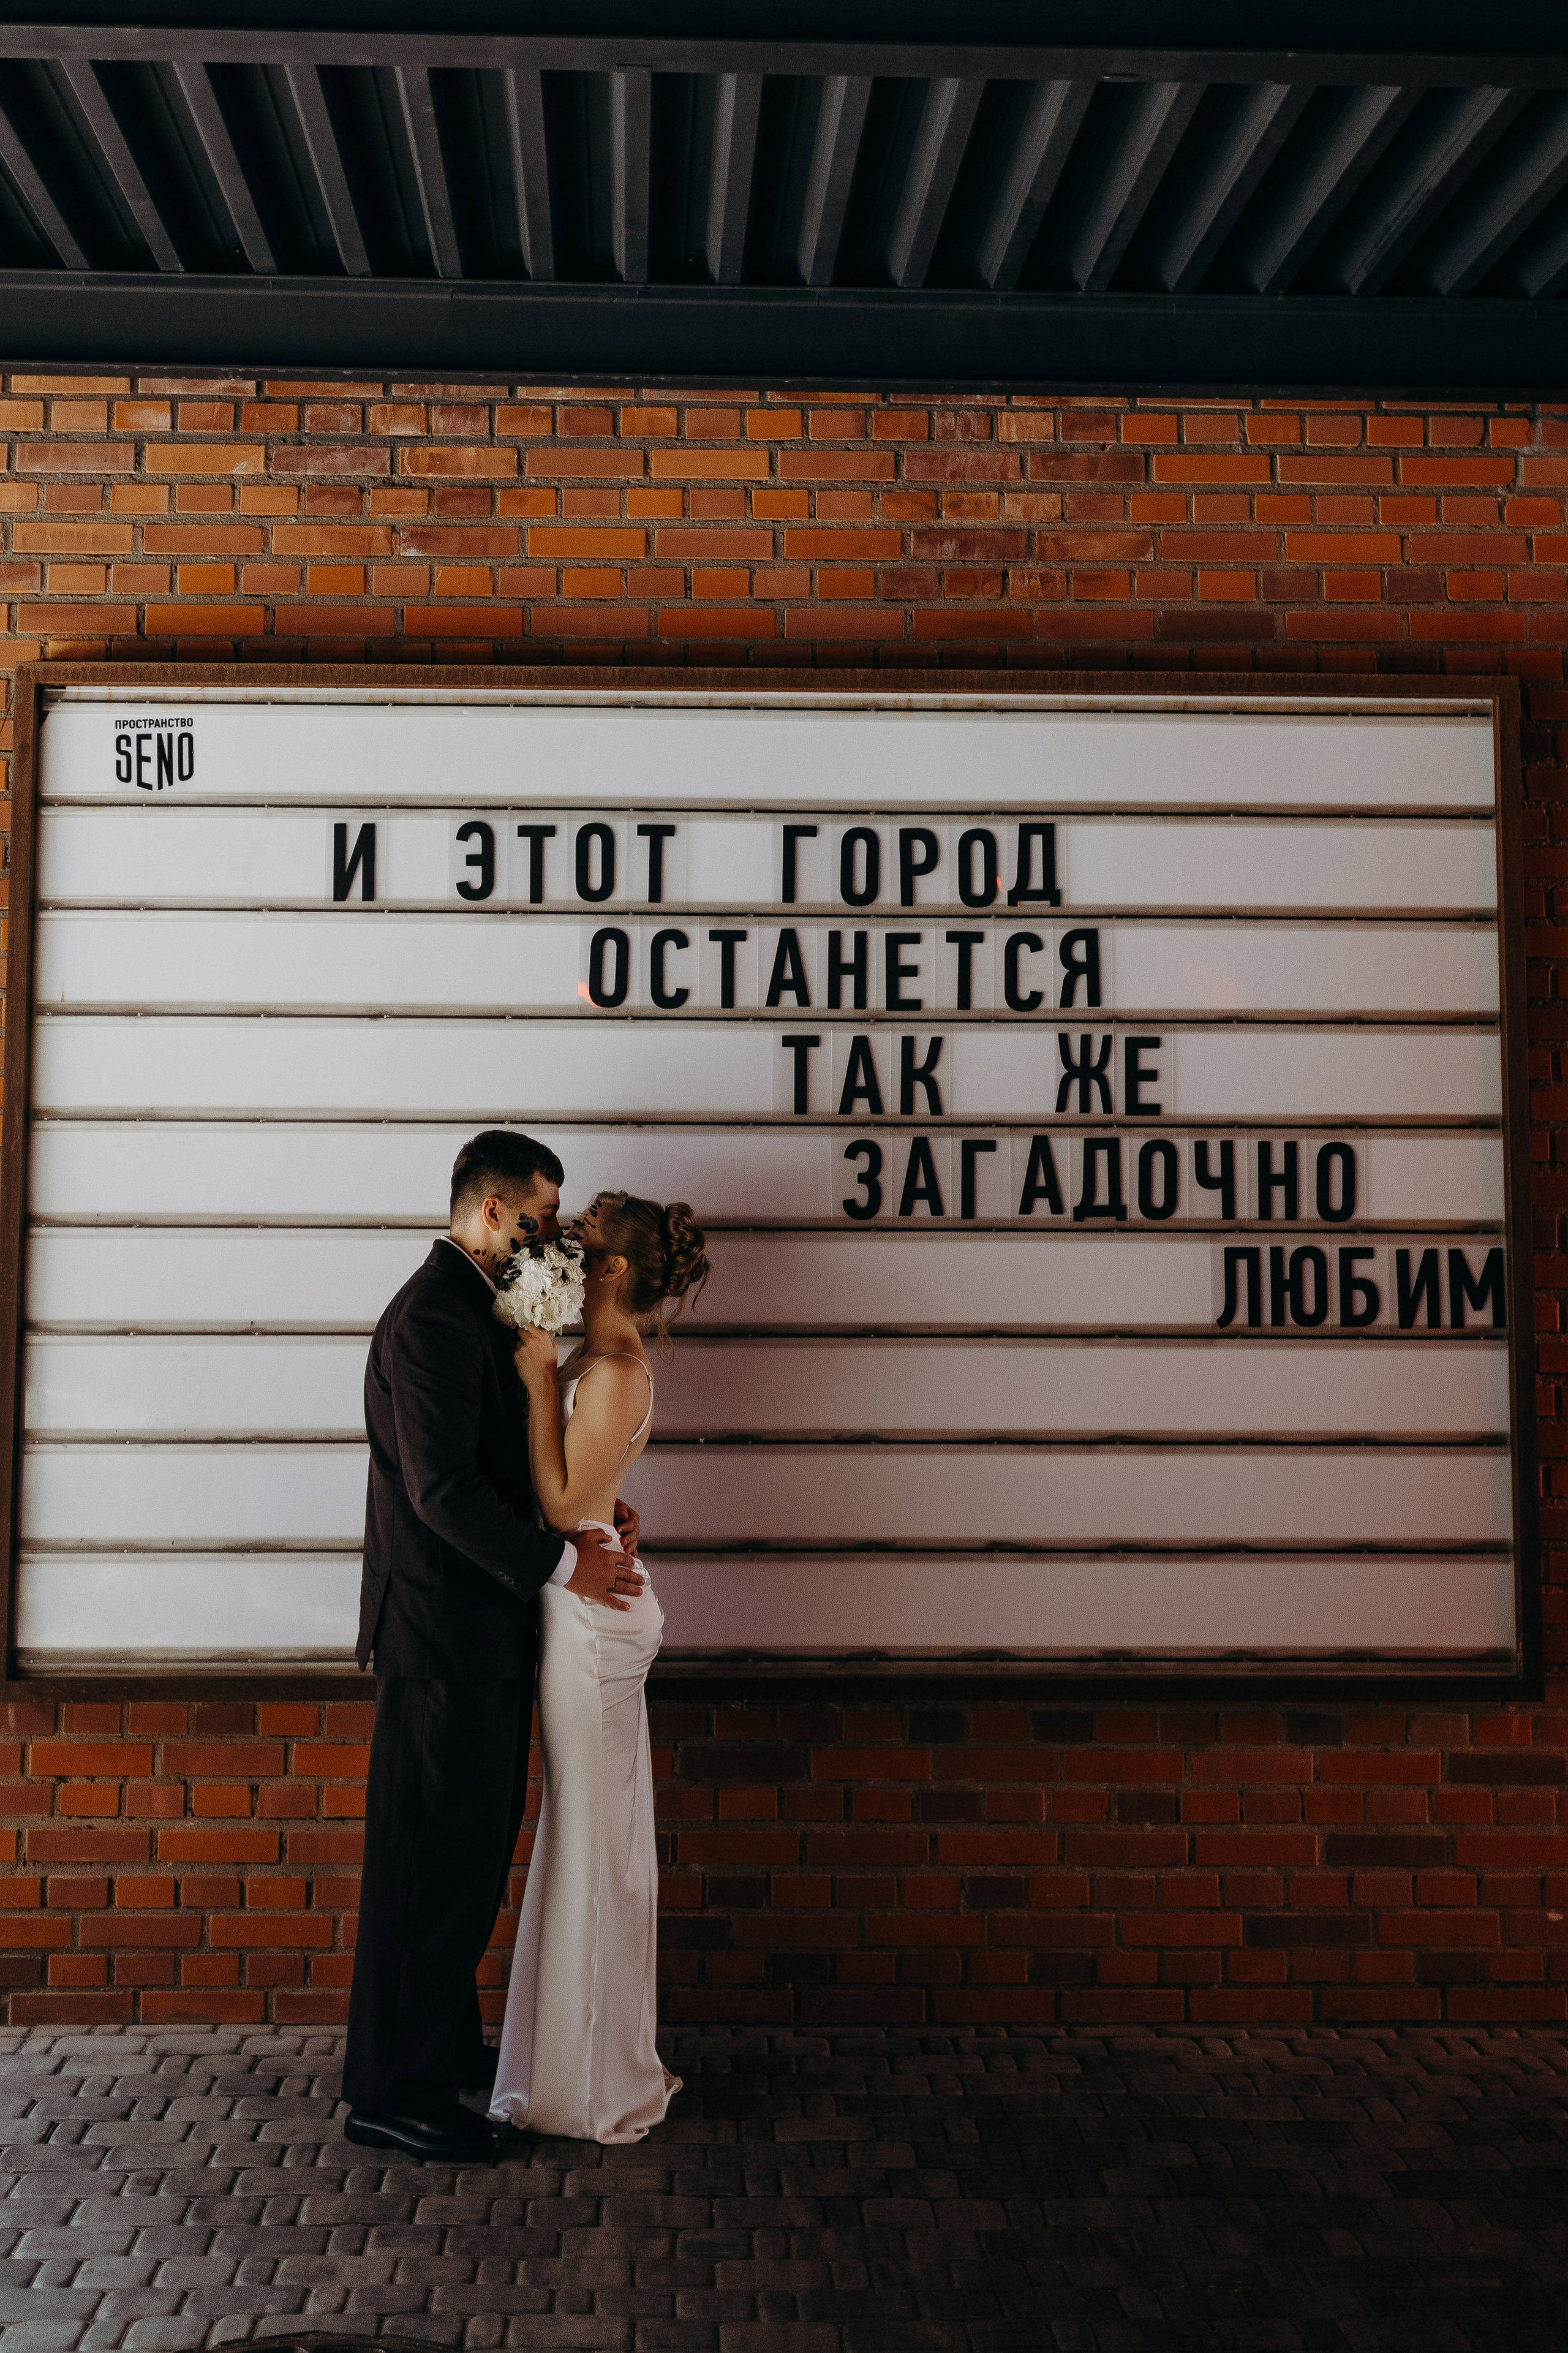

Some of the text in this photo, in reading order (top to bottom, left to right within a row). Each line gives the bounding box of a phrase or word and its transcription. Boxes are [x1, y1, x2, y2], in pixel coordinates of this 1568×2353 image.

[115, 717, 194, 729] ПРОСТРАНСТВО
[115, 732, 194, 791] SENO
[333, 821, 1063, 910] И ЭТОТ ГОРОД
[589, 927, 1102, 1012] ОСТАНЕТСЯ
[782, 1032, 1163, 1119] ТАК ЖЕ
[843, 1133, 1357, 1223] ЗАГАДОЧНО
[1216, 1245, 1506, 1329] ЛЮБИМ
